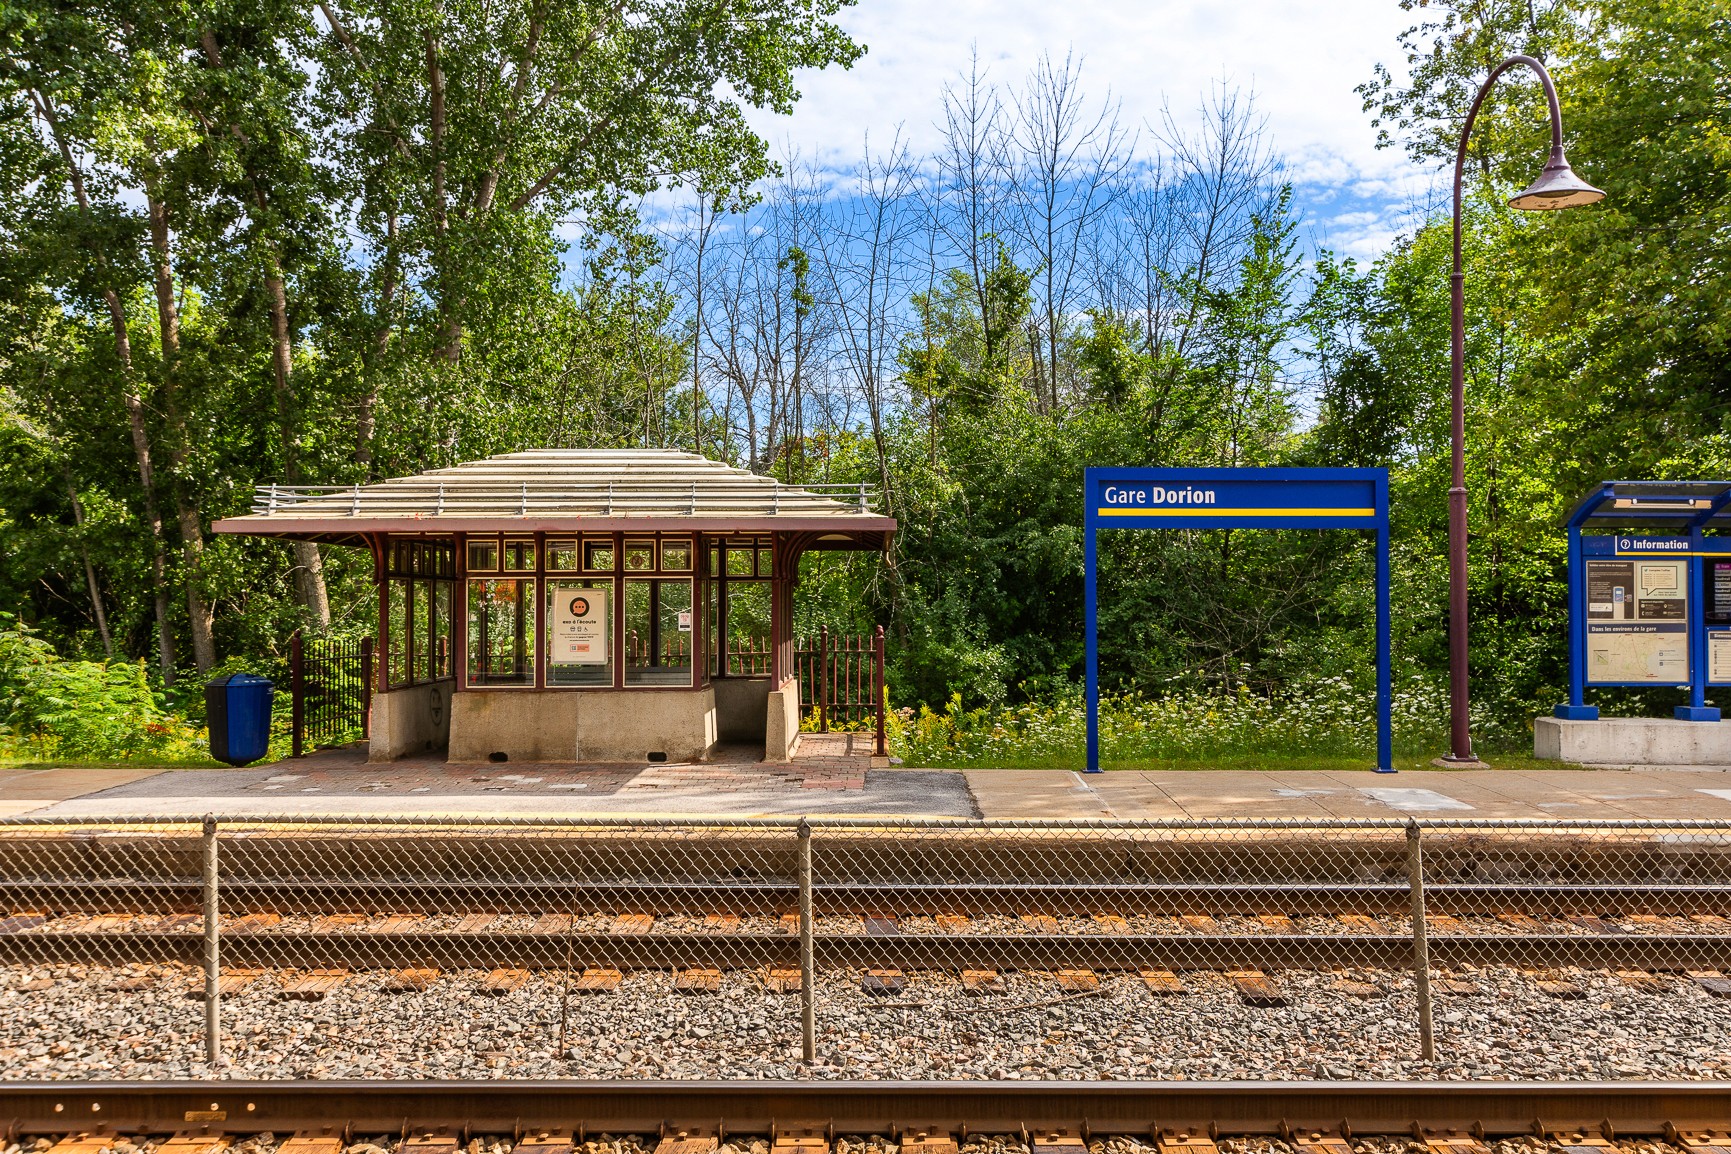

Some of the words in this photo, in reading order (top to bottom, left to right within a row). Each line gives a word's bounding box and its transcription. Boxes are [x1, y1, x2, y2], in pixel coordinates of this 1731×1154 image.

[1104, 486, 1146, 504] Gare
[1152, 486, 1216, 504] Dorion
[1633, 539, 1689, 550] Information
